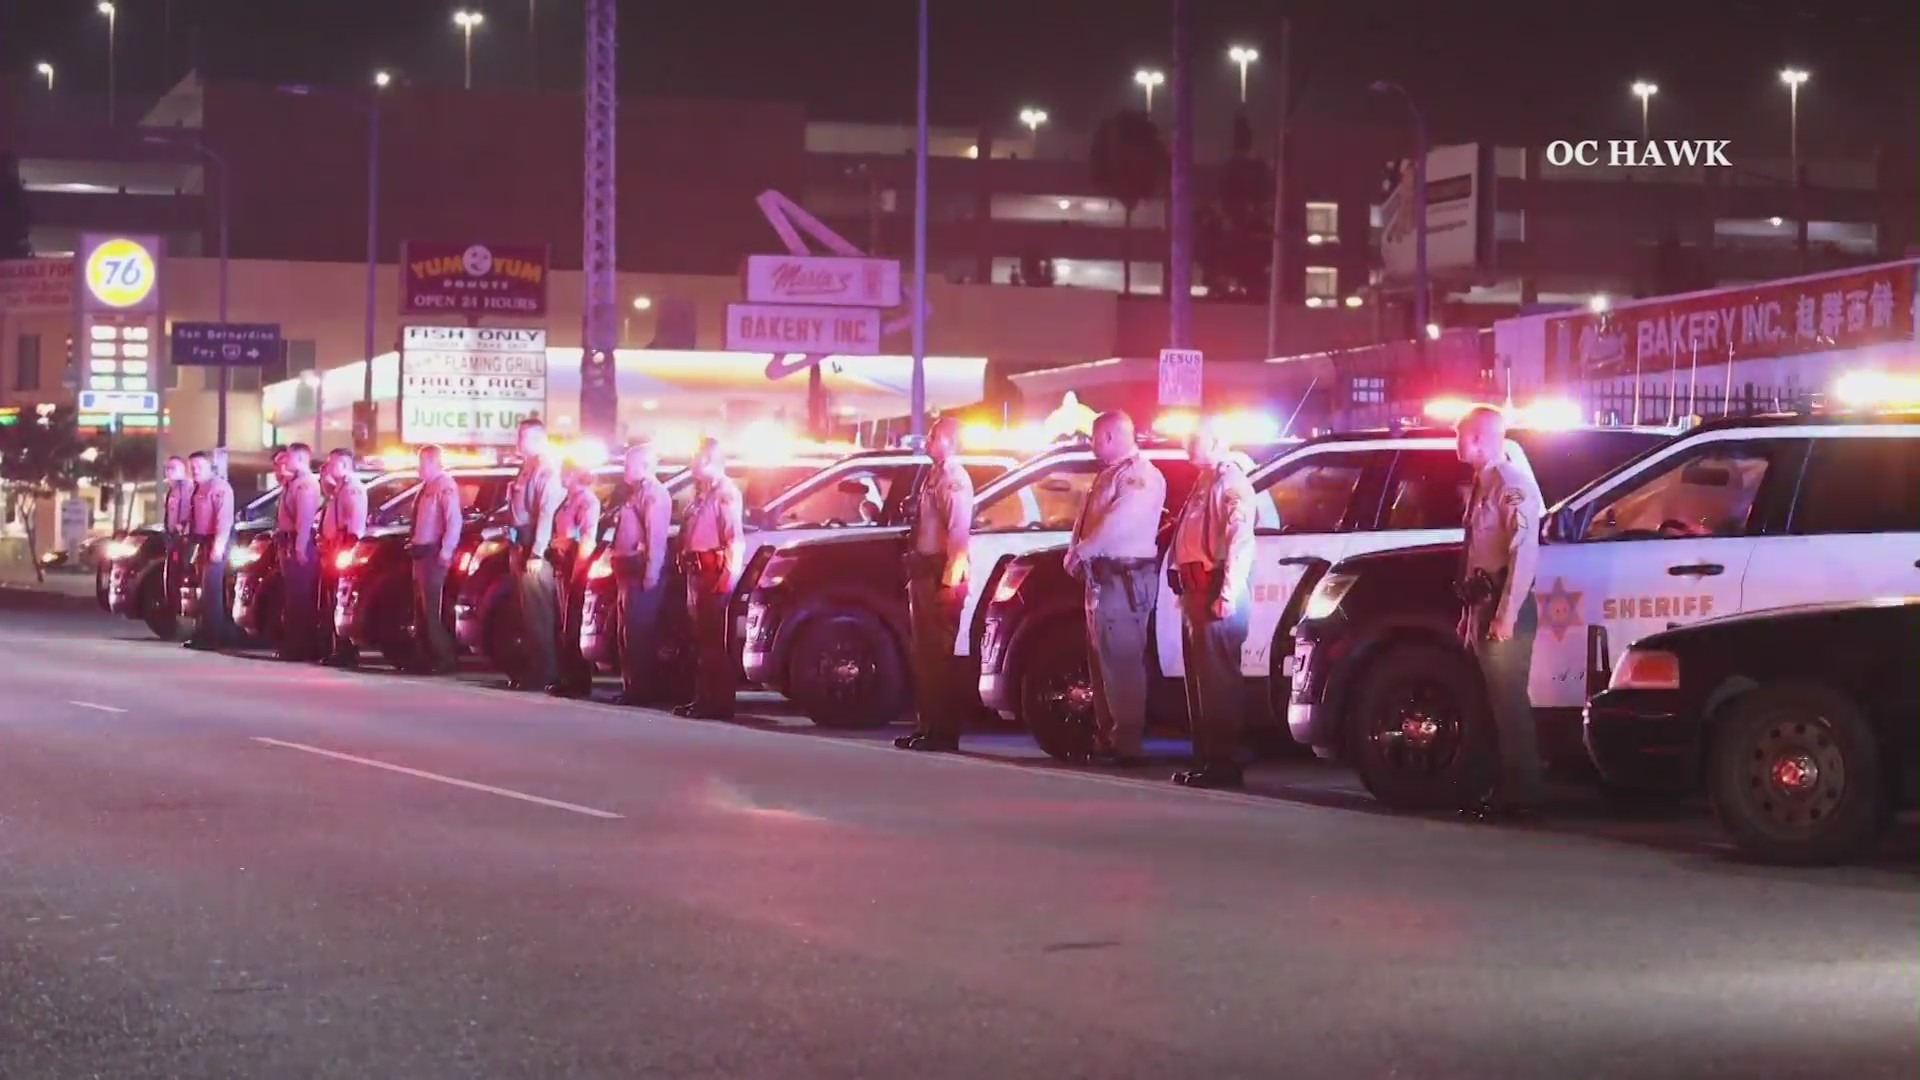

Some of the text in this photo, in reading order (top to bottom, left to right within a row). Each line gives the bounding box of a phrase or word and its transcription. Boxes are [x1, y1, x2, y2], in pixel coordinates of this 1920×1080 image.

[104, 258, 141, 286] 76
[411, 255, 542, 284] YUM YUM
[443, 279, 508, 290] DONUTS
[414, 294, 455, 307] OPEN
[484, 296, 537, 310] HOURS
[179, 328, 274, 340] San Bernardino
[410, 329, 539, 342] FISH ONLY
[741, 315, 823, 342] BAKERY
[1637, 307, 1736, 358] BAKERY
[445, 355, 501, 372] FLAMING
[505, 357, 543, 374] GRILL
[1162, 353, 1200, 365] JESUS
[411, 408, 468, 428] JUICE
[476, 411, 495, 428] IT
[1603, 595, 1713, 620] SHERIFF
